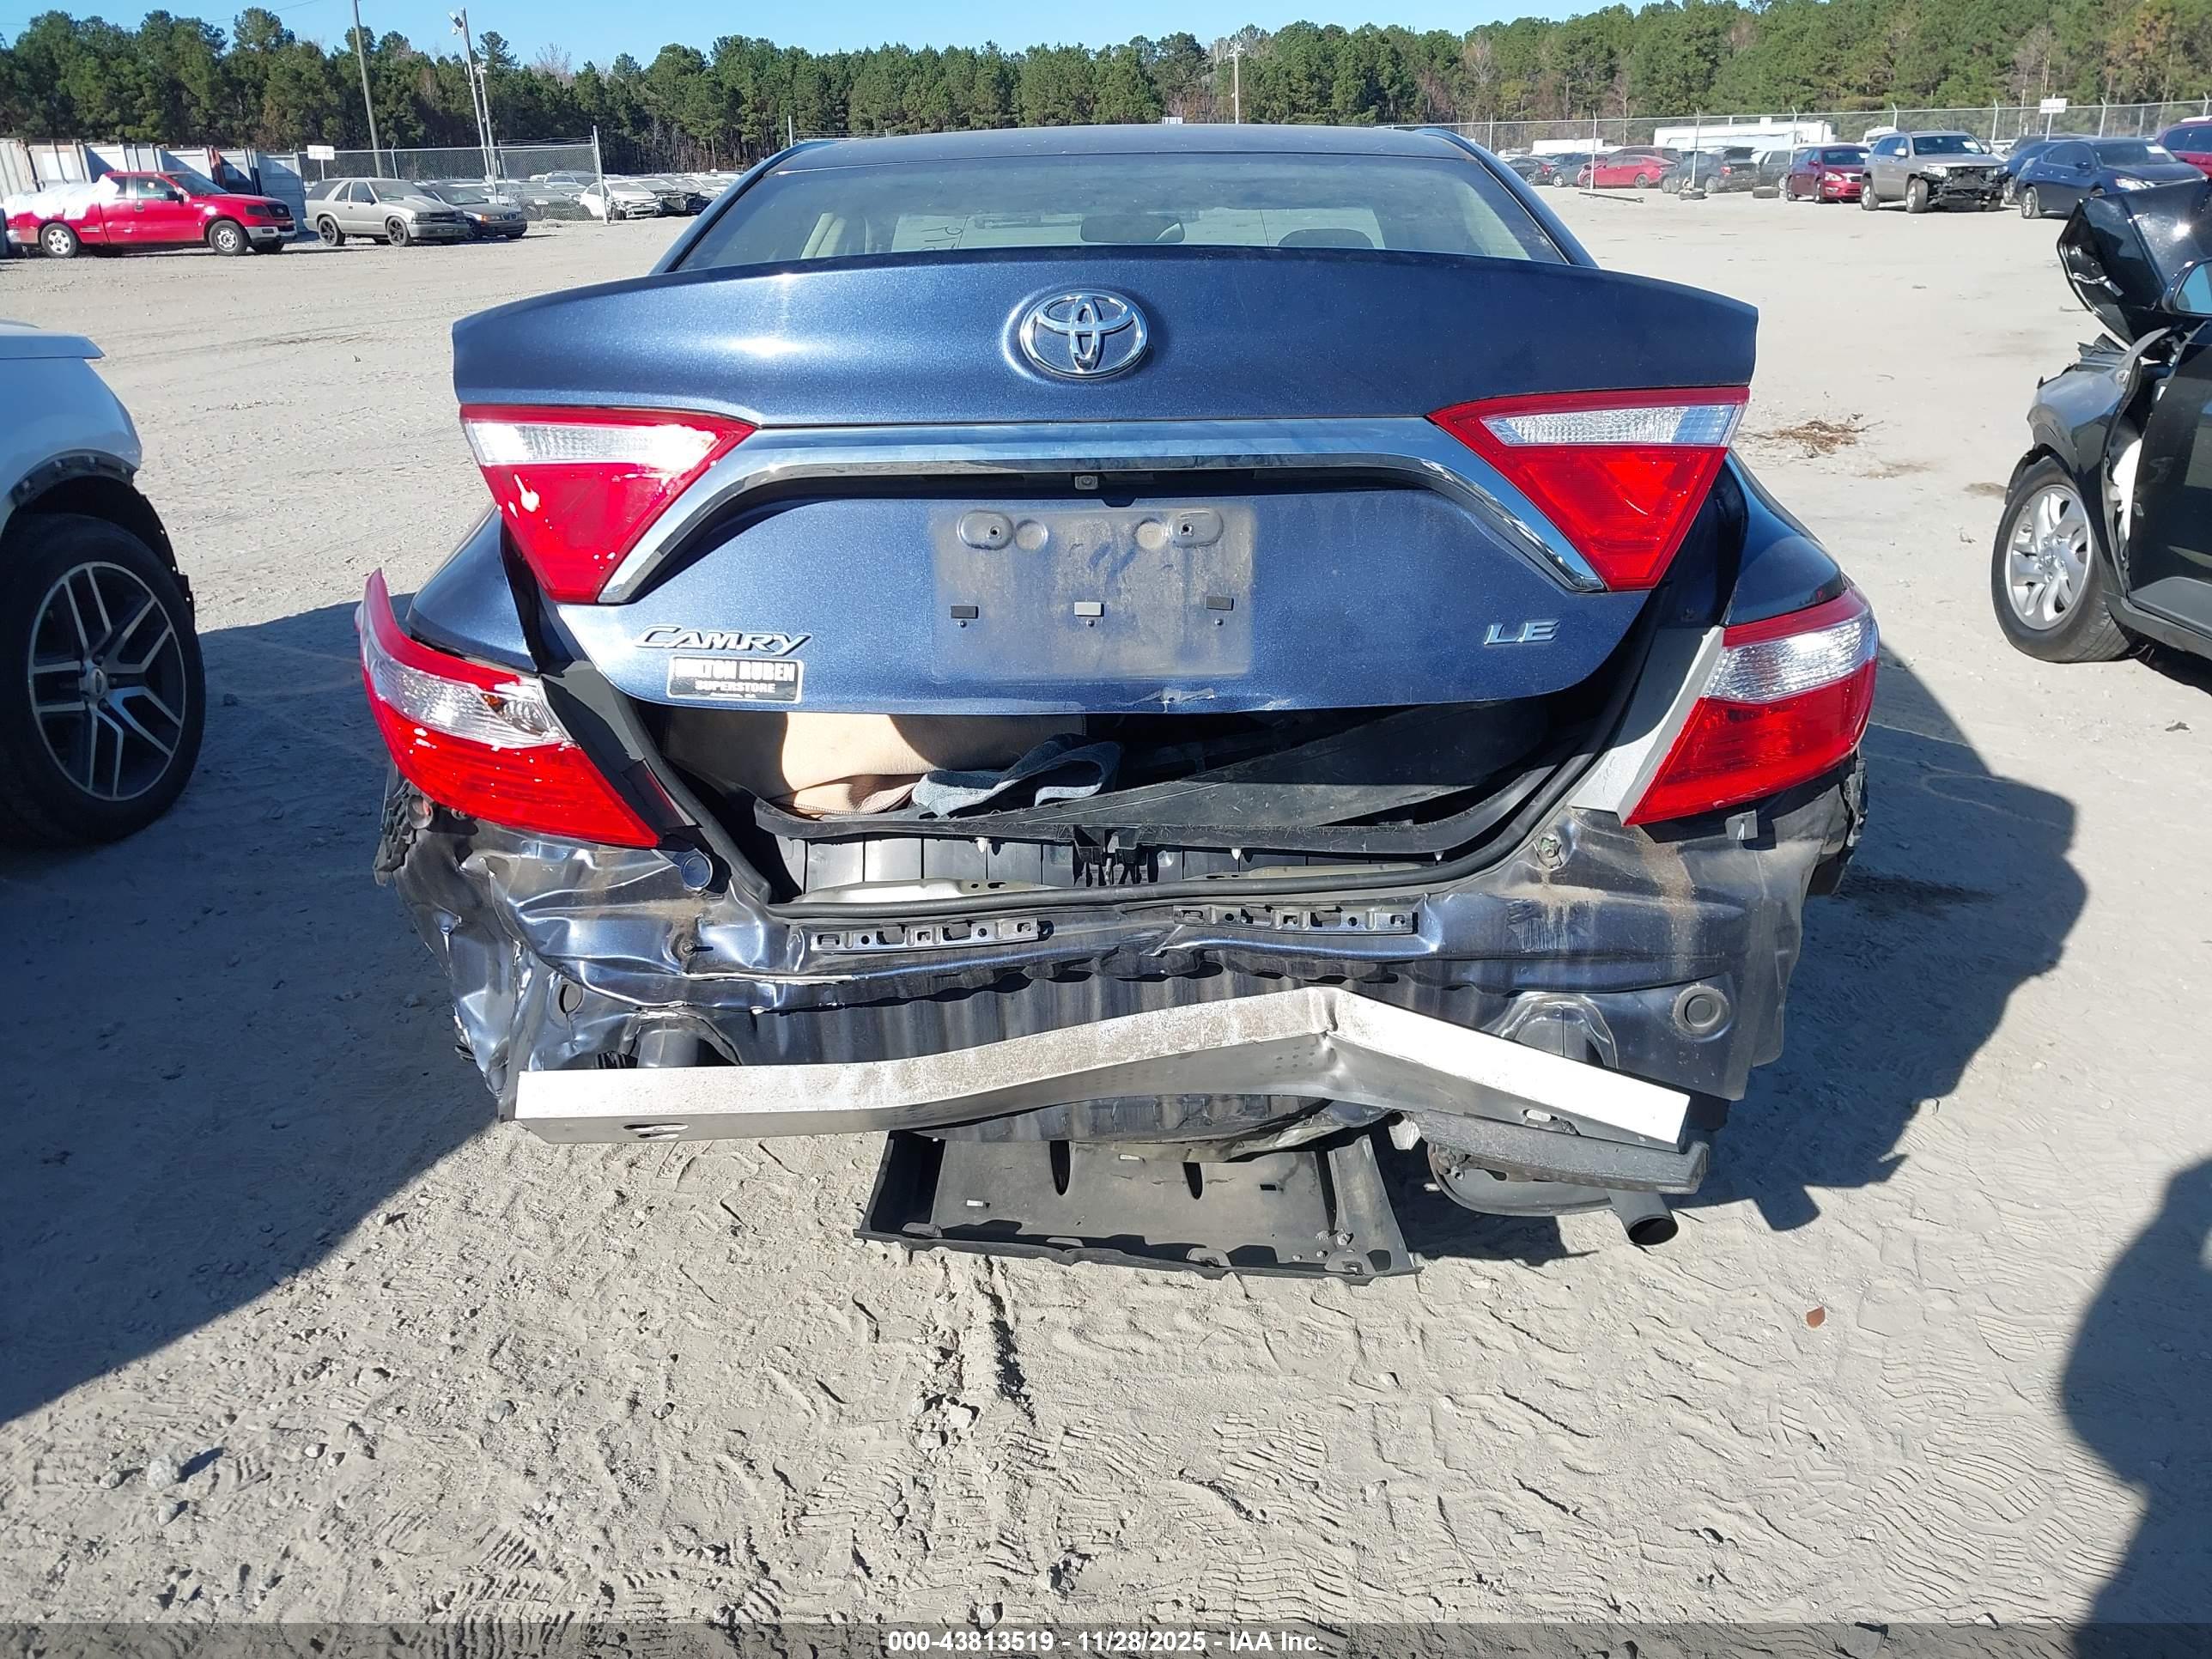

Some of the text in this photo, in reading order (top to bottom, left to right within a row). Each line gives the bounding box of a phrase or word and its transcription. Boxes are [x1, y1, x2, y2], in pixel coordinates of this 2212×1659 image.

[635, 626, 811, 657] CAMRY
[1484, 619, 1560, 646] LE
[738, 661, 796, 683] RUBEN
[694, 679, 776, 695] SUPERSTORE
